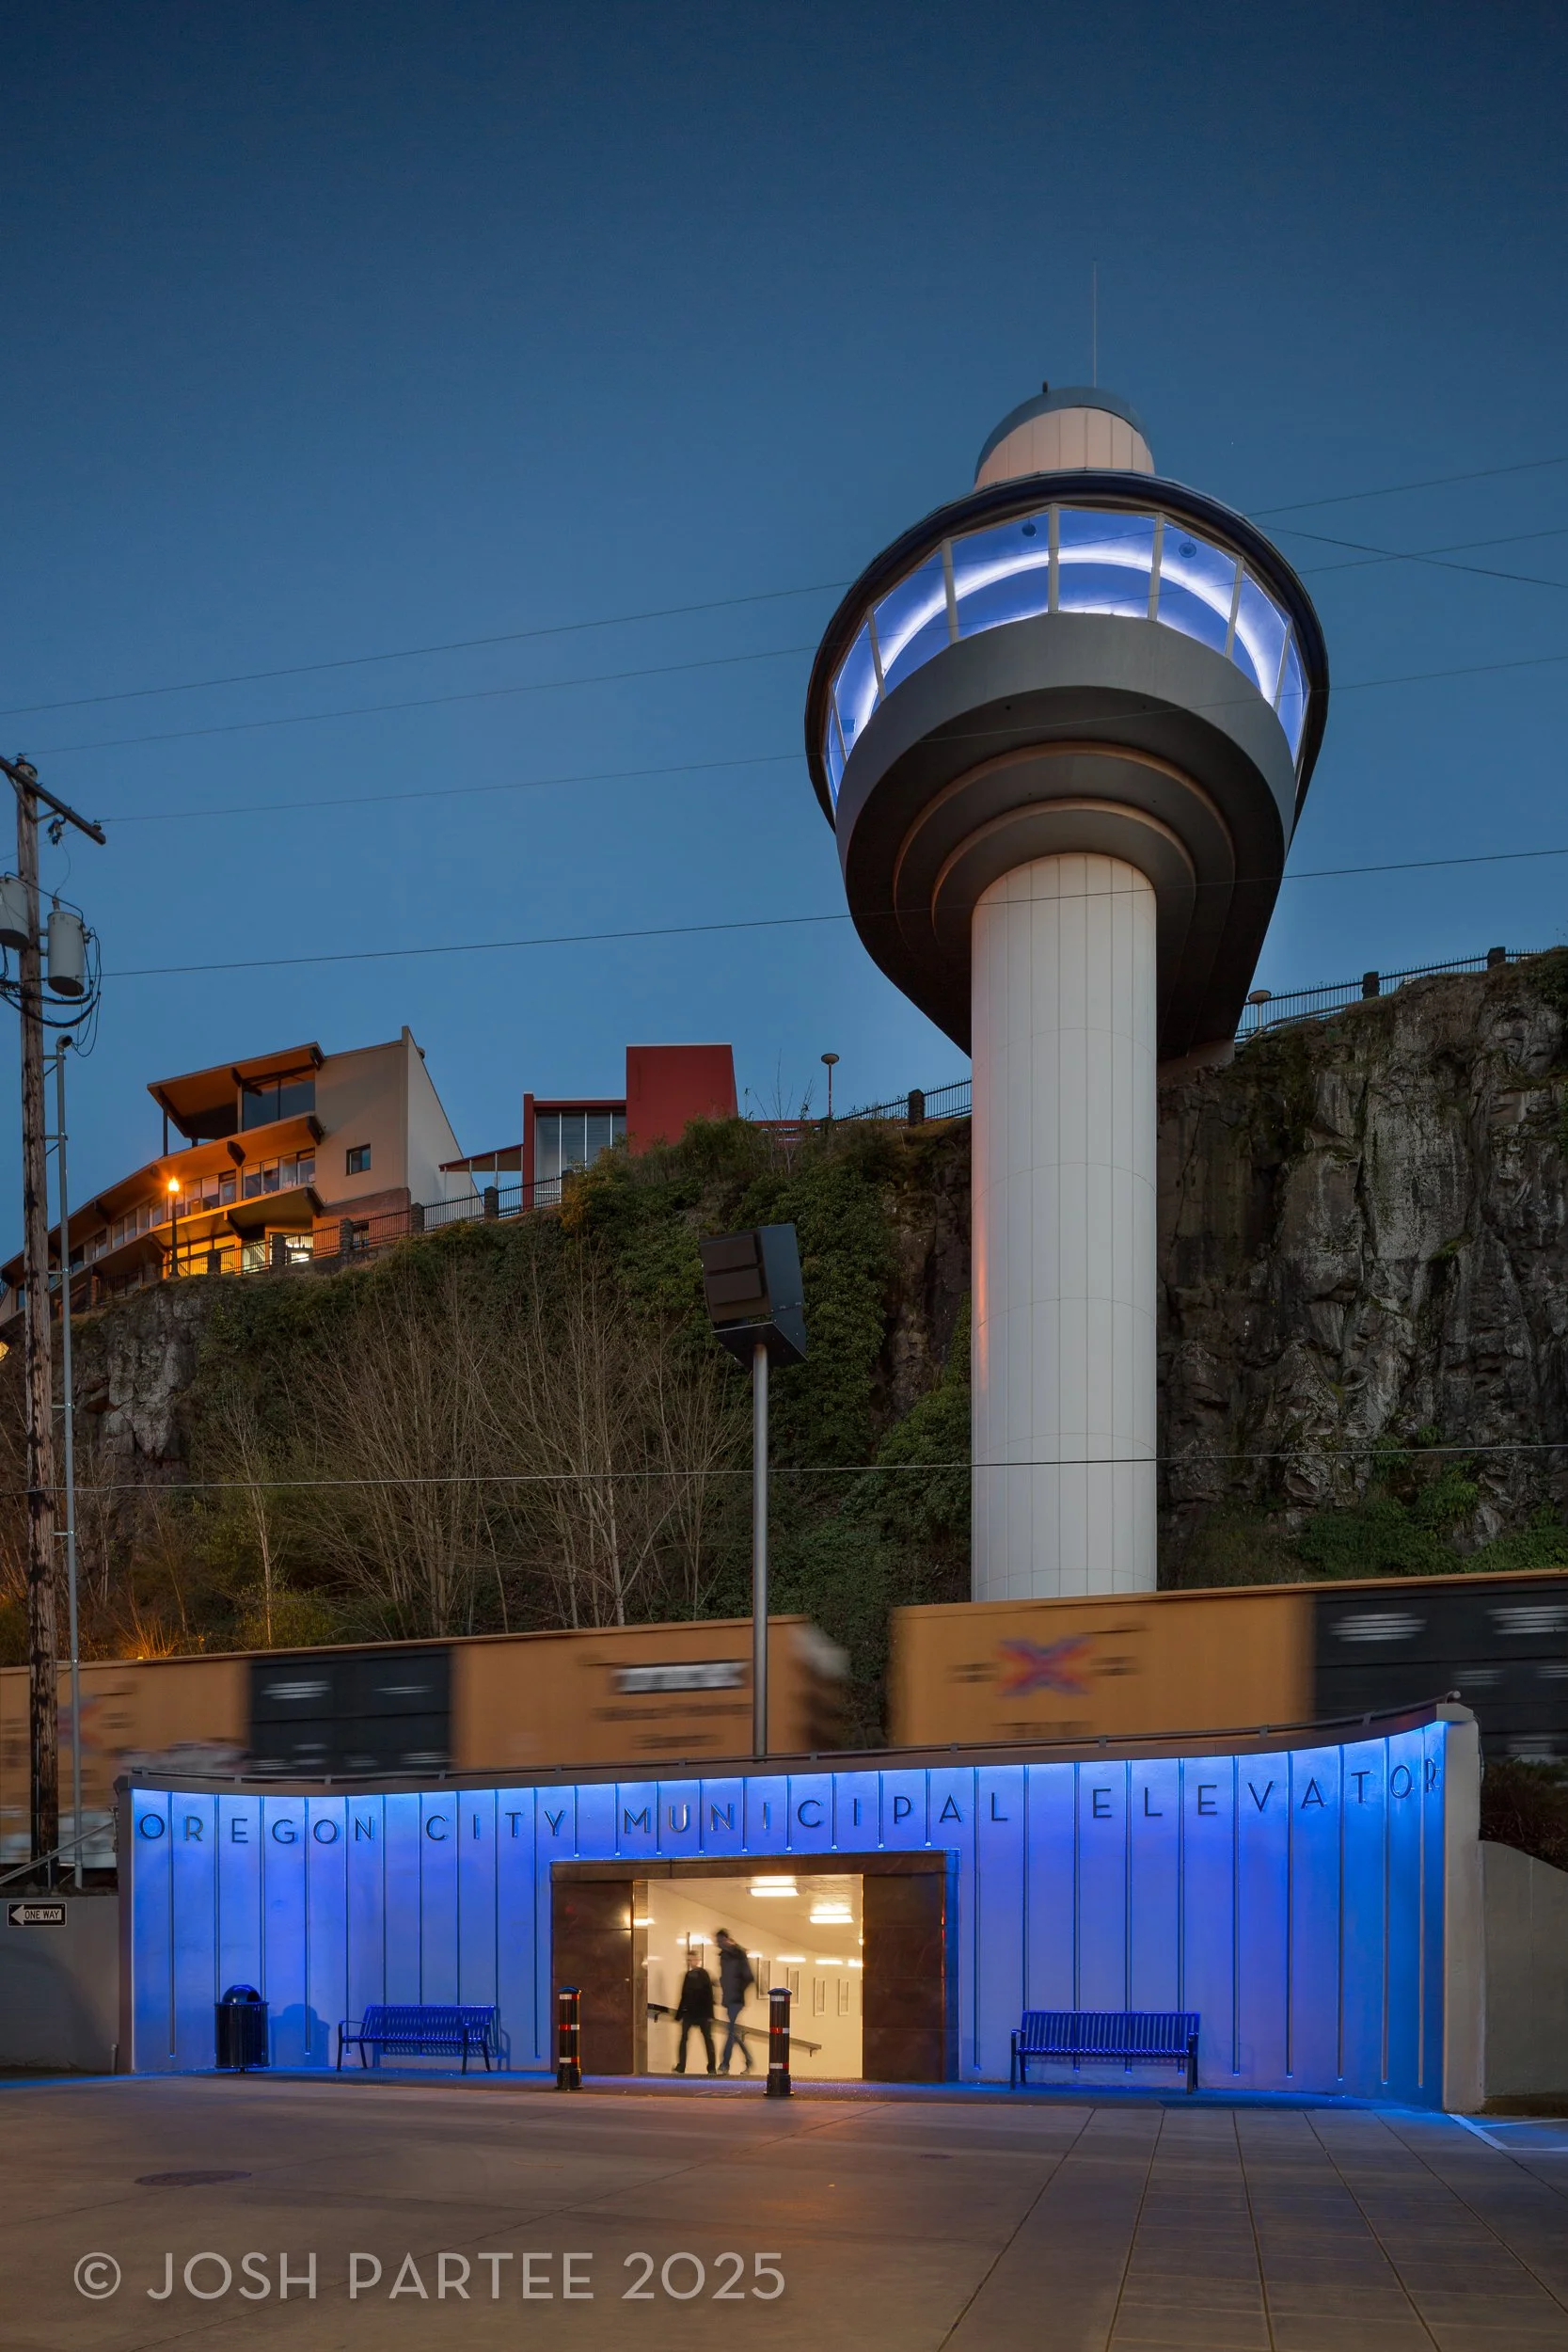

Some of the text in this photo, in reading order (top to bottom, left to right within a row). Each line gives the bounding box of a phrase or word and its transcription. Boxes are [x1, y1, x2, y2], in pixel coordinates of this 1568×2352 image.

[139, 1757, 1440, 1845] OREGON CITY MUNICIPAL ELEVATOR
[24, 1910, 59, 1919] ONE WAY
